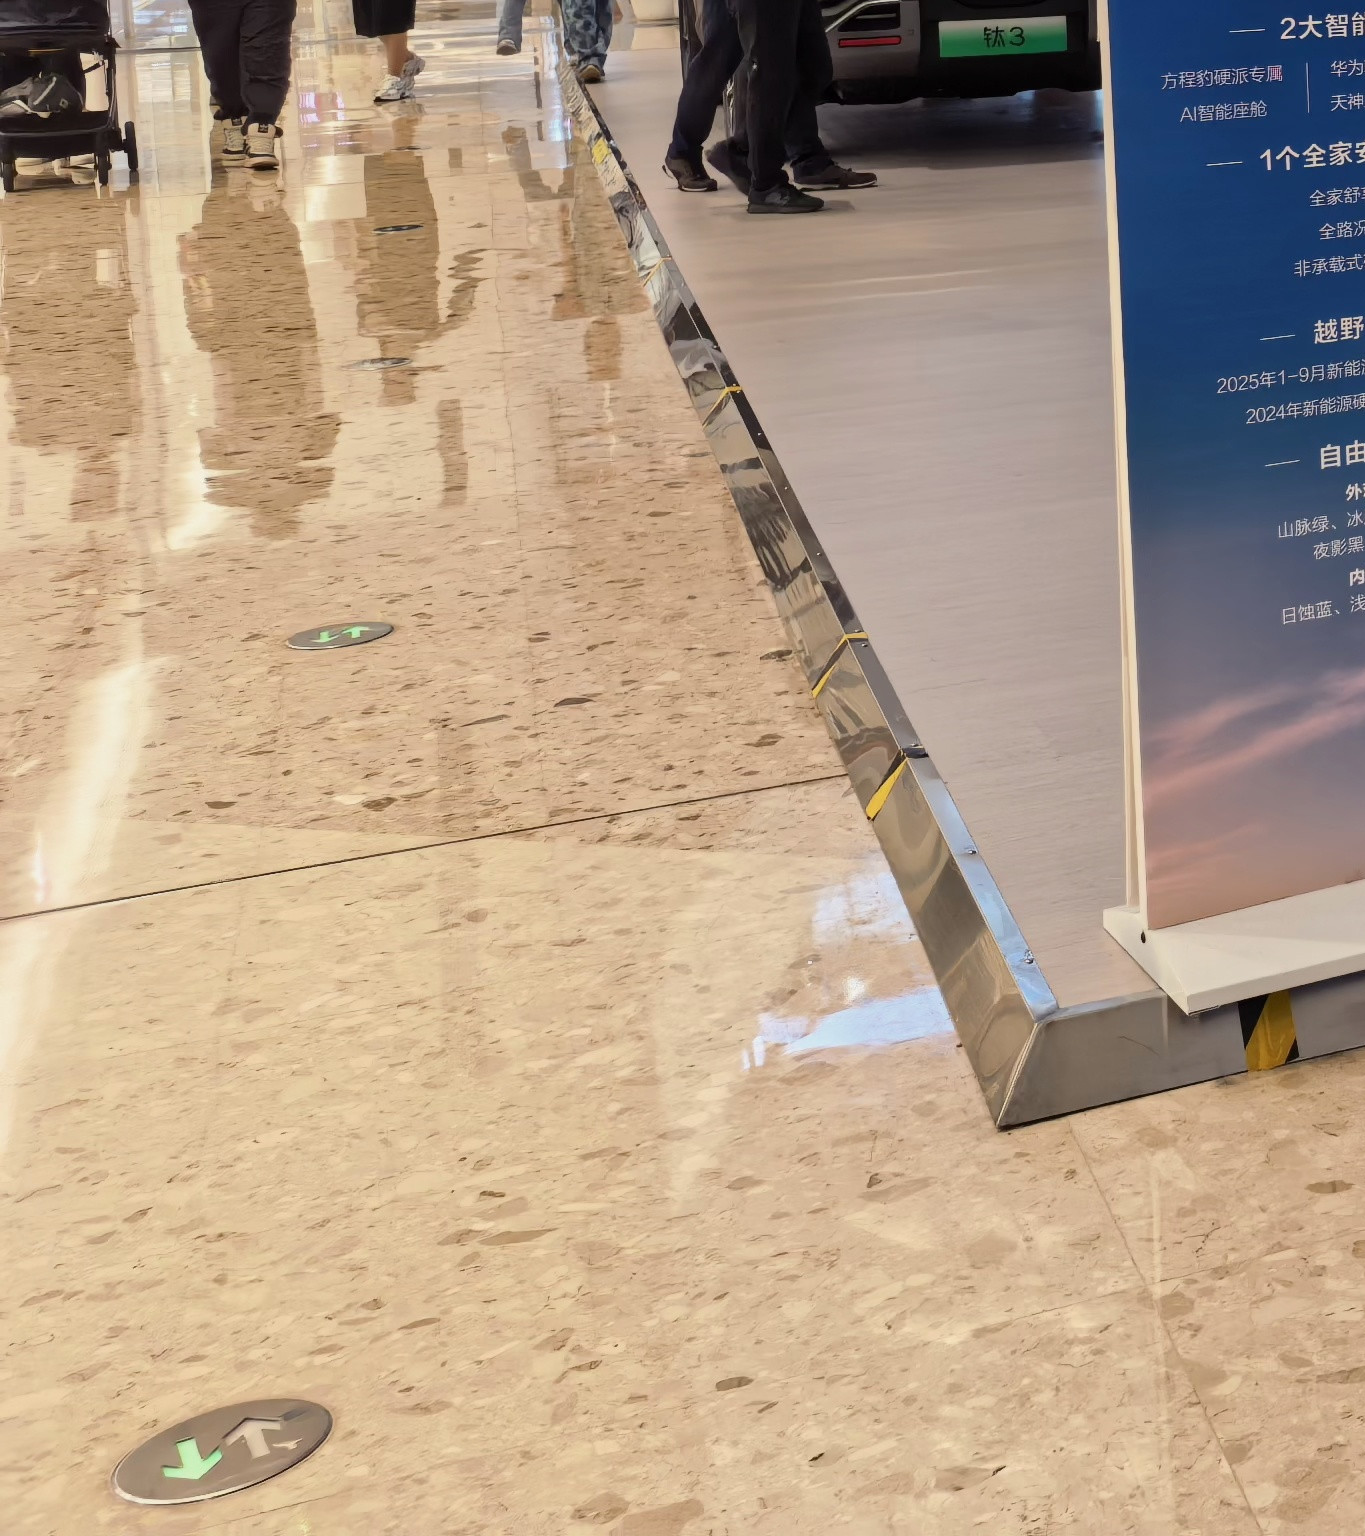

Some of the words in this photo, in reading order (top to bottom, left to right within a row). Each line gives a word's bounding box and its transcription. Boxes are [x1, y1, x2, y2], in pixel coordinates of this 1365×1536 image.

[984, 26, 1025, 48] 钛3
[1160, 65, 1283, 90] 方程豹硬派专属
[1180, 101, 1267, 123] AI智能座舱
